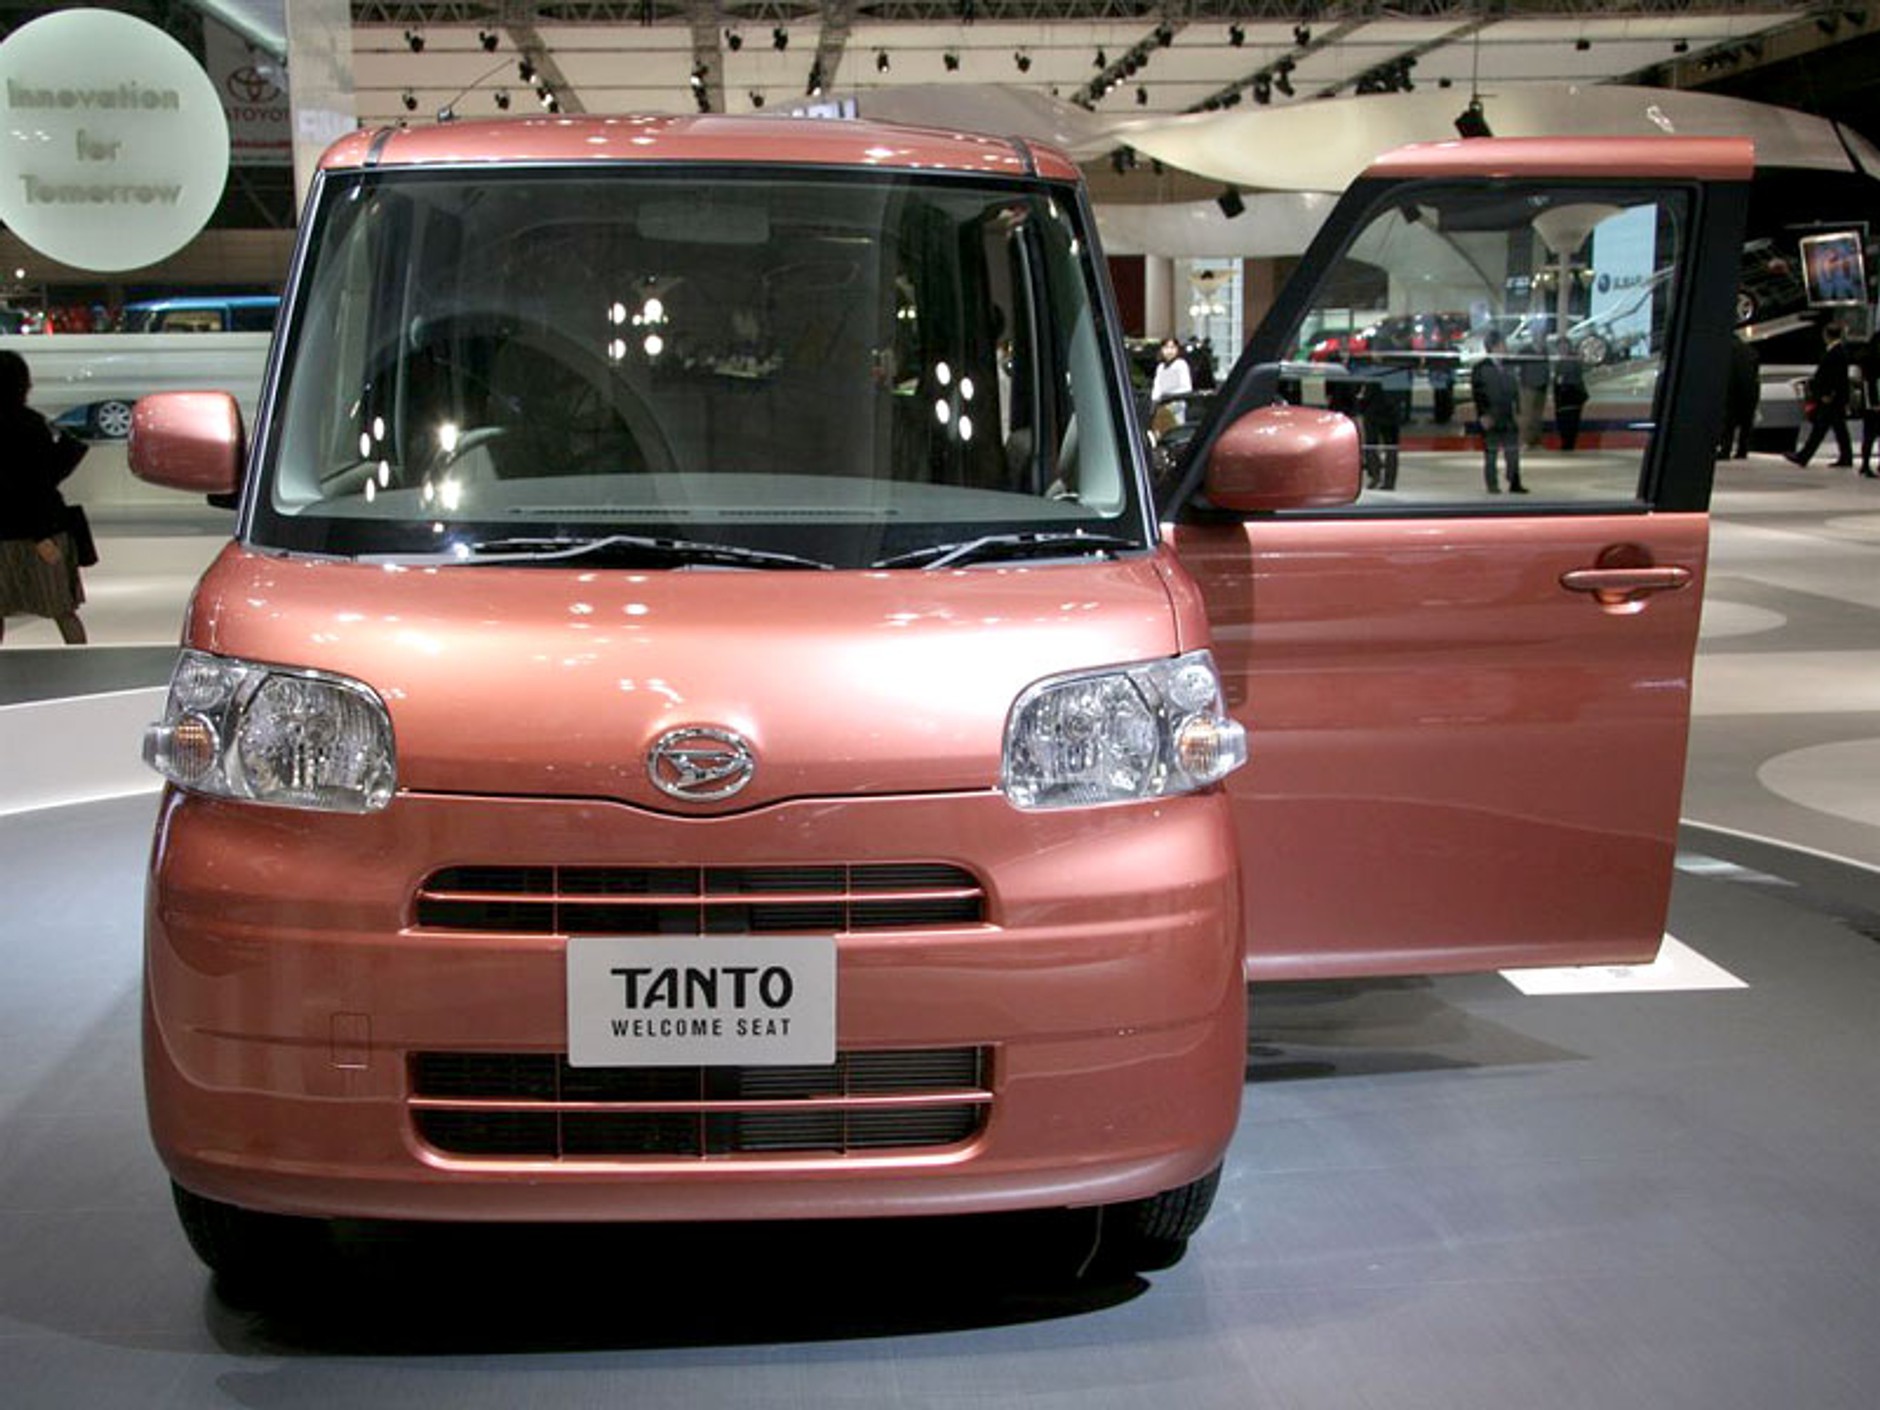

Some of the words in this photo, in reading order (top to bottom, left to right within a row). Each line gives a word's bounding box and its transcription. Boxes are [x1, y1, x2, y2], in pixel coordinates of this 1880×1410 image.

[7, 78, 180, 110] Innovation
[76, 129, 121, 161] for
[20, 174, 182, 205] Tomorrow
[610, 966, 793, 1009] TANTO
[611, 1018, 723, 1037] WELCOME
[736, 1018, 791, 1036] SEAT
